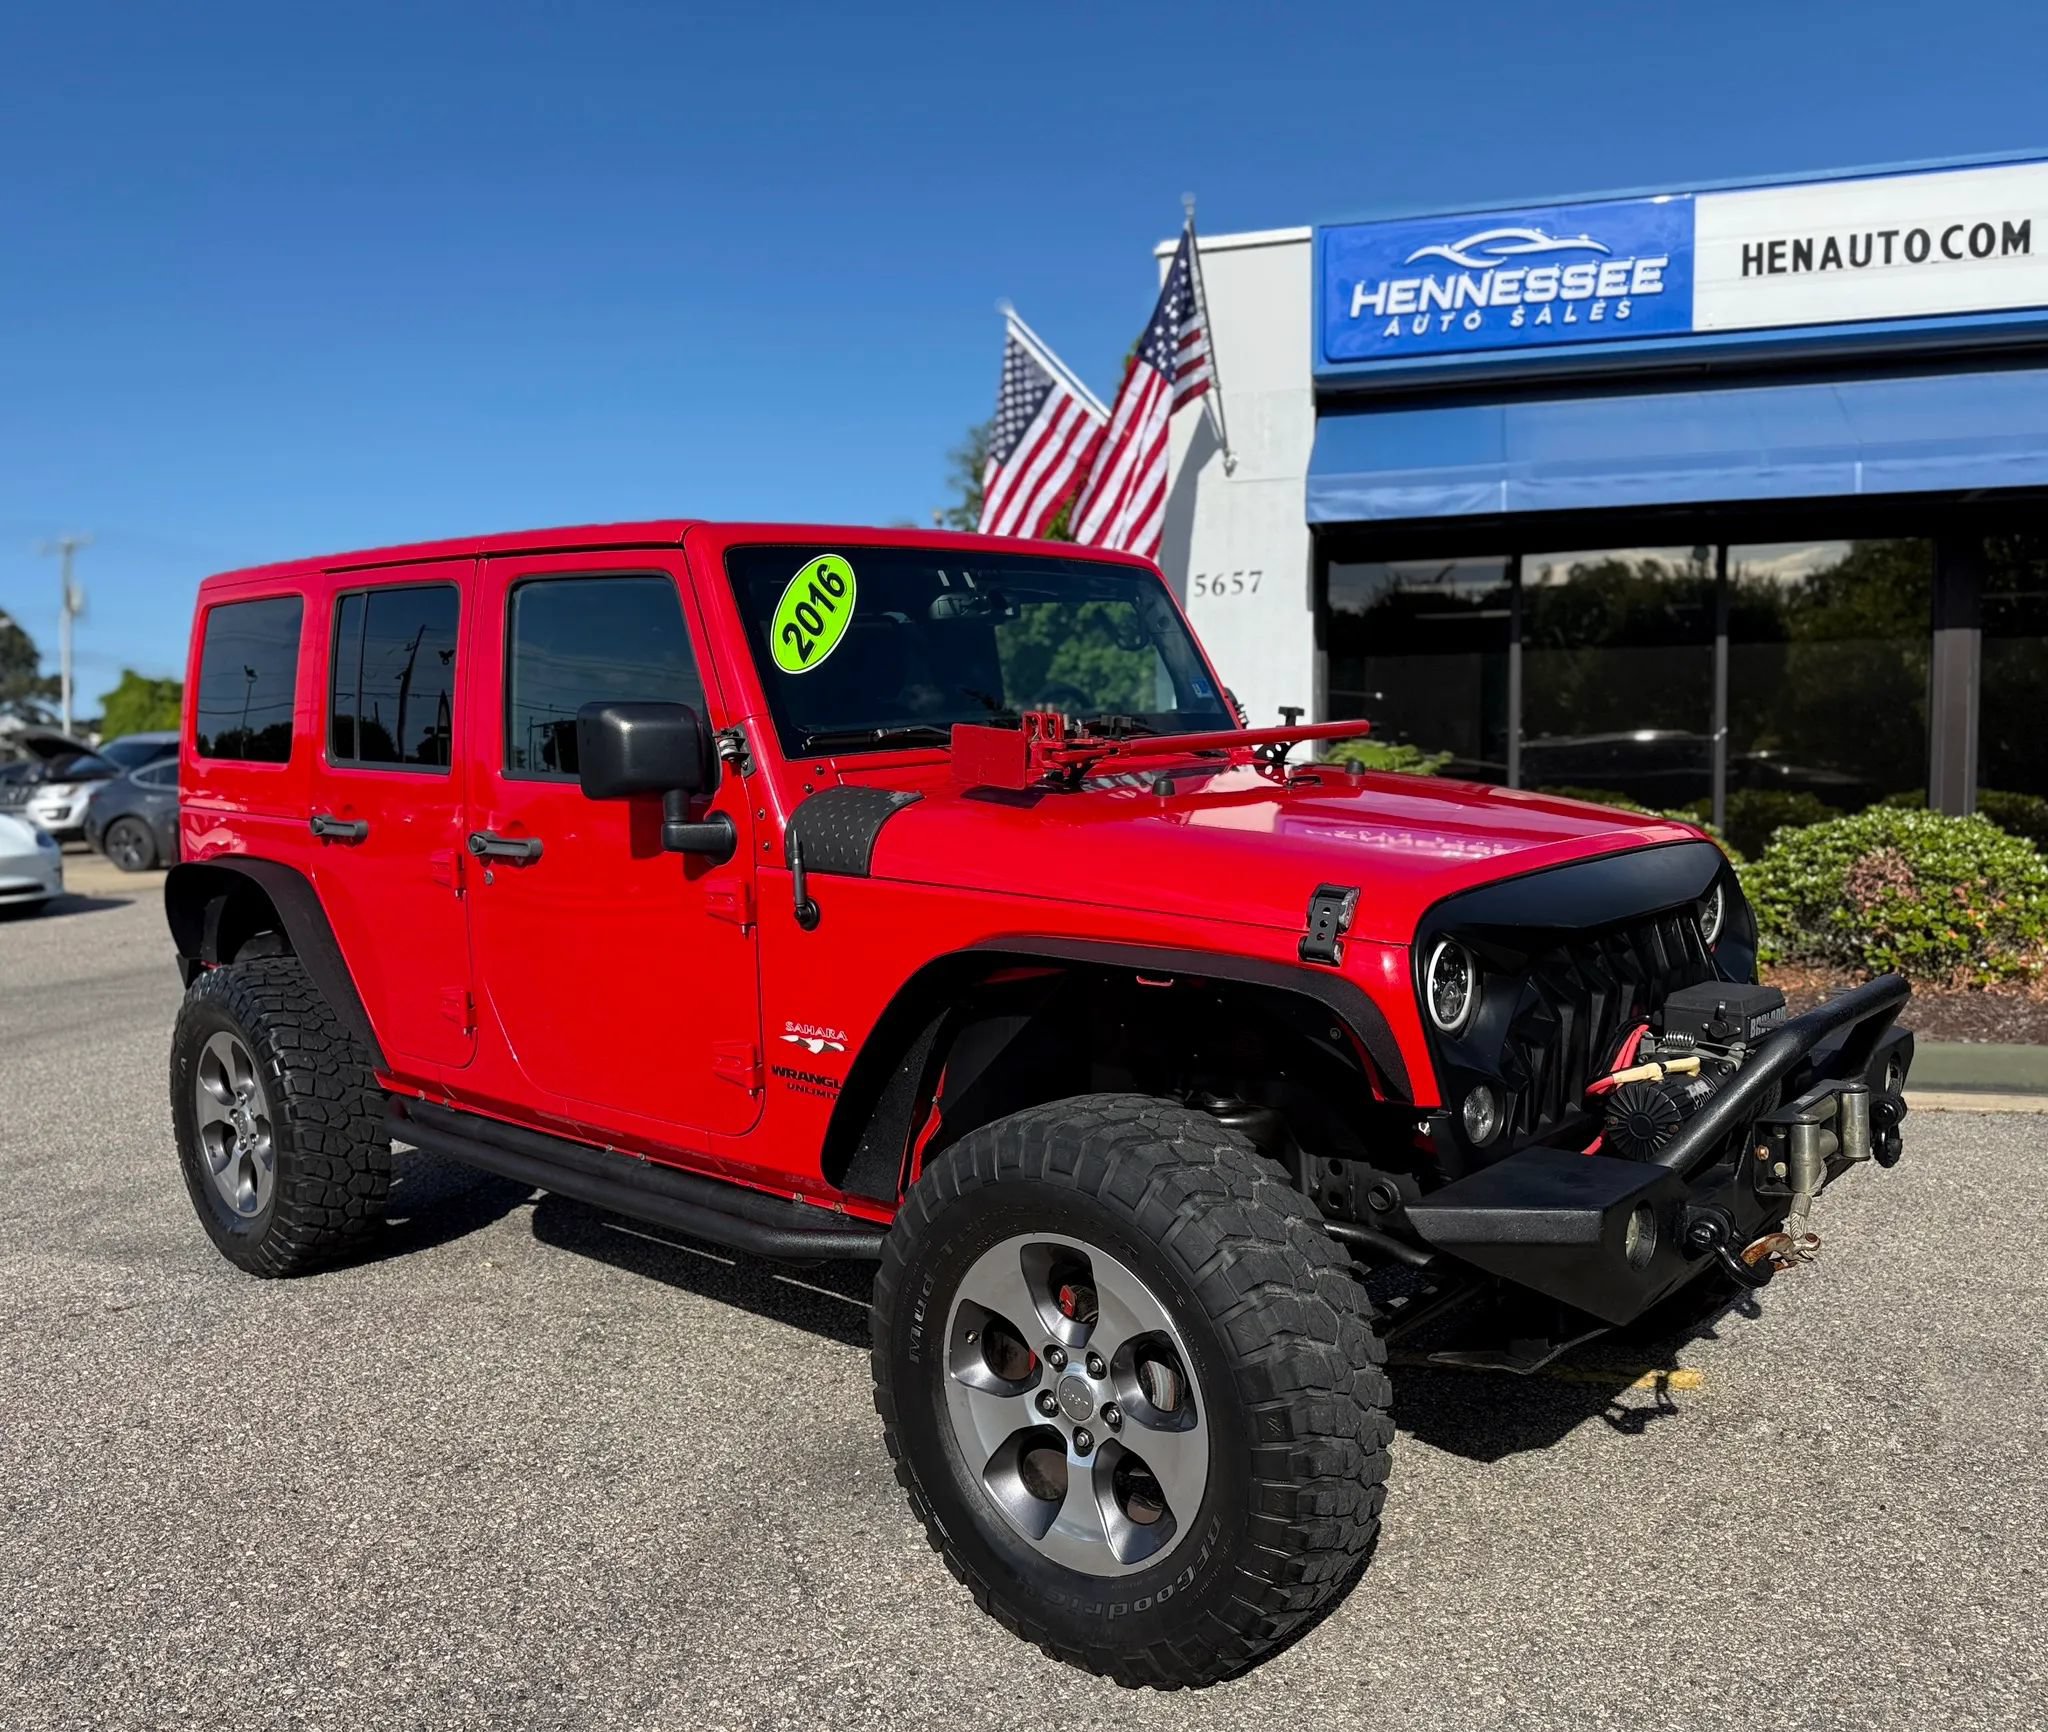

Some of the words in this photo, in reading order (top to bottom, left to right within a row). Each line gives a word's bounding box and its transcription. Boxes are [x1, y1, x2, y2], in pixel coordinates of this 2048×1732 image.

[1350, 253, 1668, 319] HENNESSEE
[1383, 310, 1483, 337] AUTO
[1509, 298, 1632, 327] SALES
[1194, 570, 1263, 598] 5657
[782, 563, 846, 665] 2016
[785, 1021, 848, 1041] SAHARA
[771, 1064, 844, 1091] WRANGL
